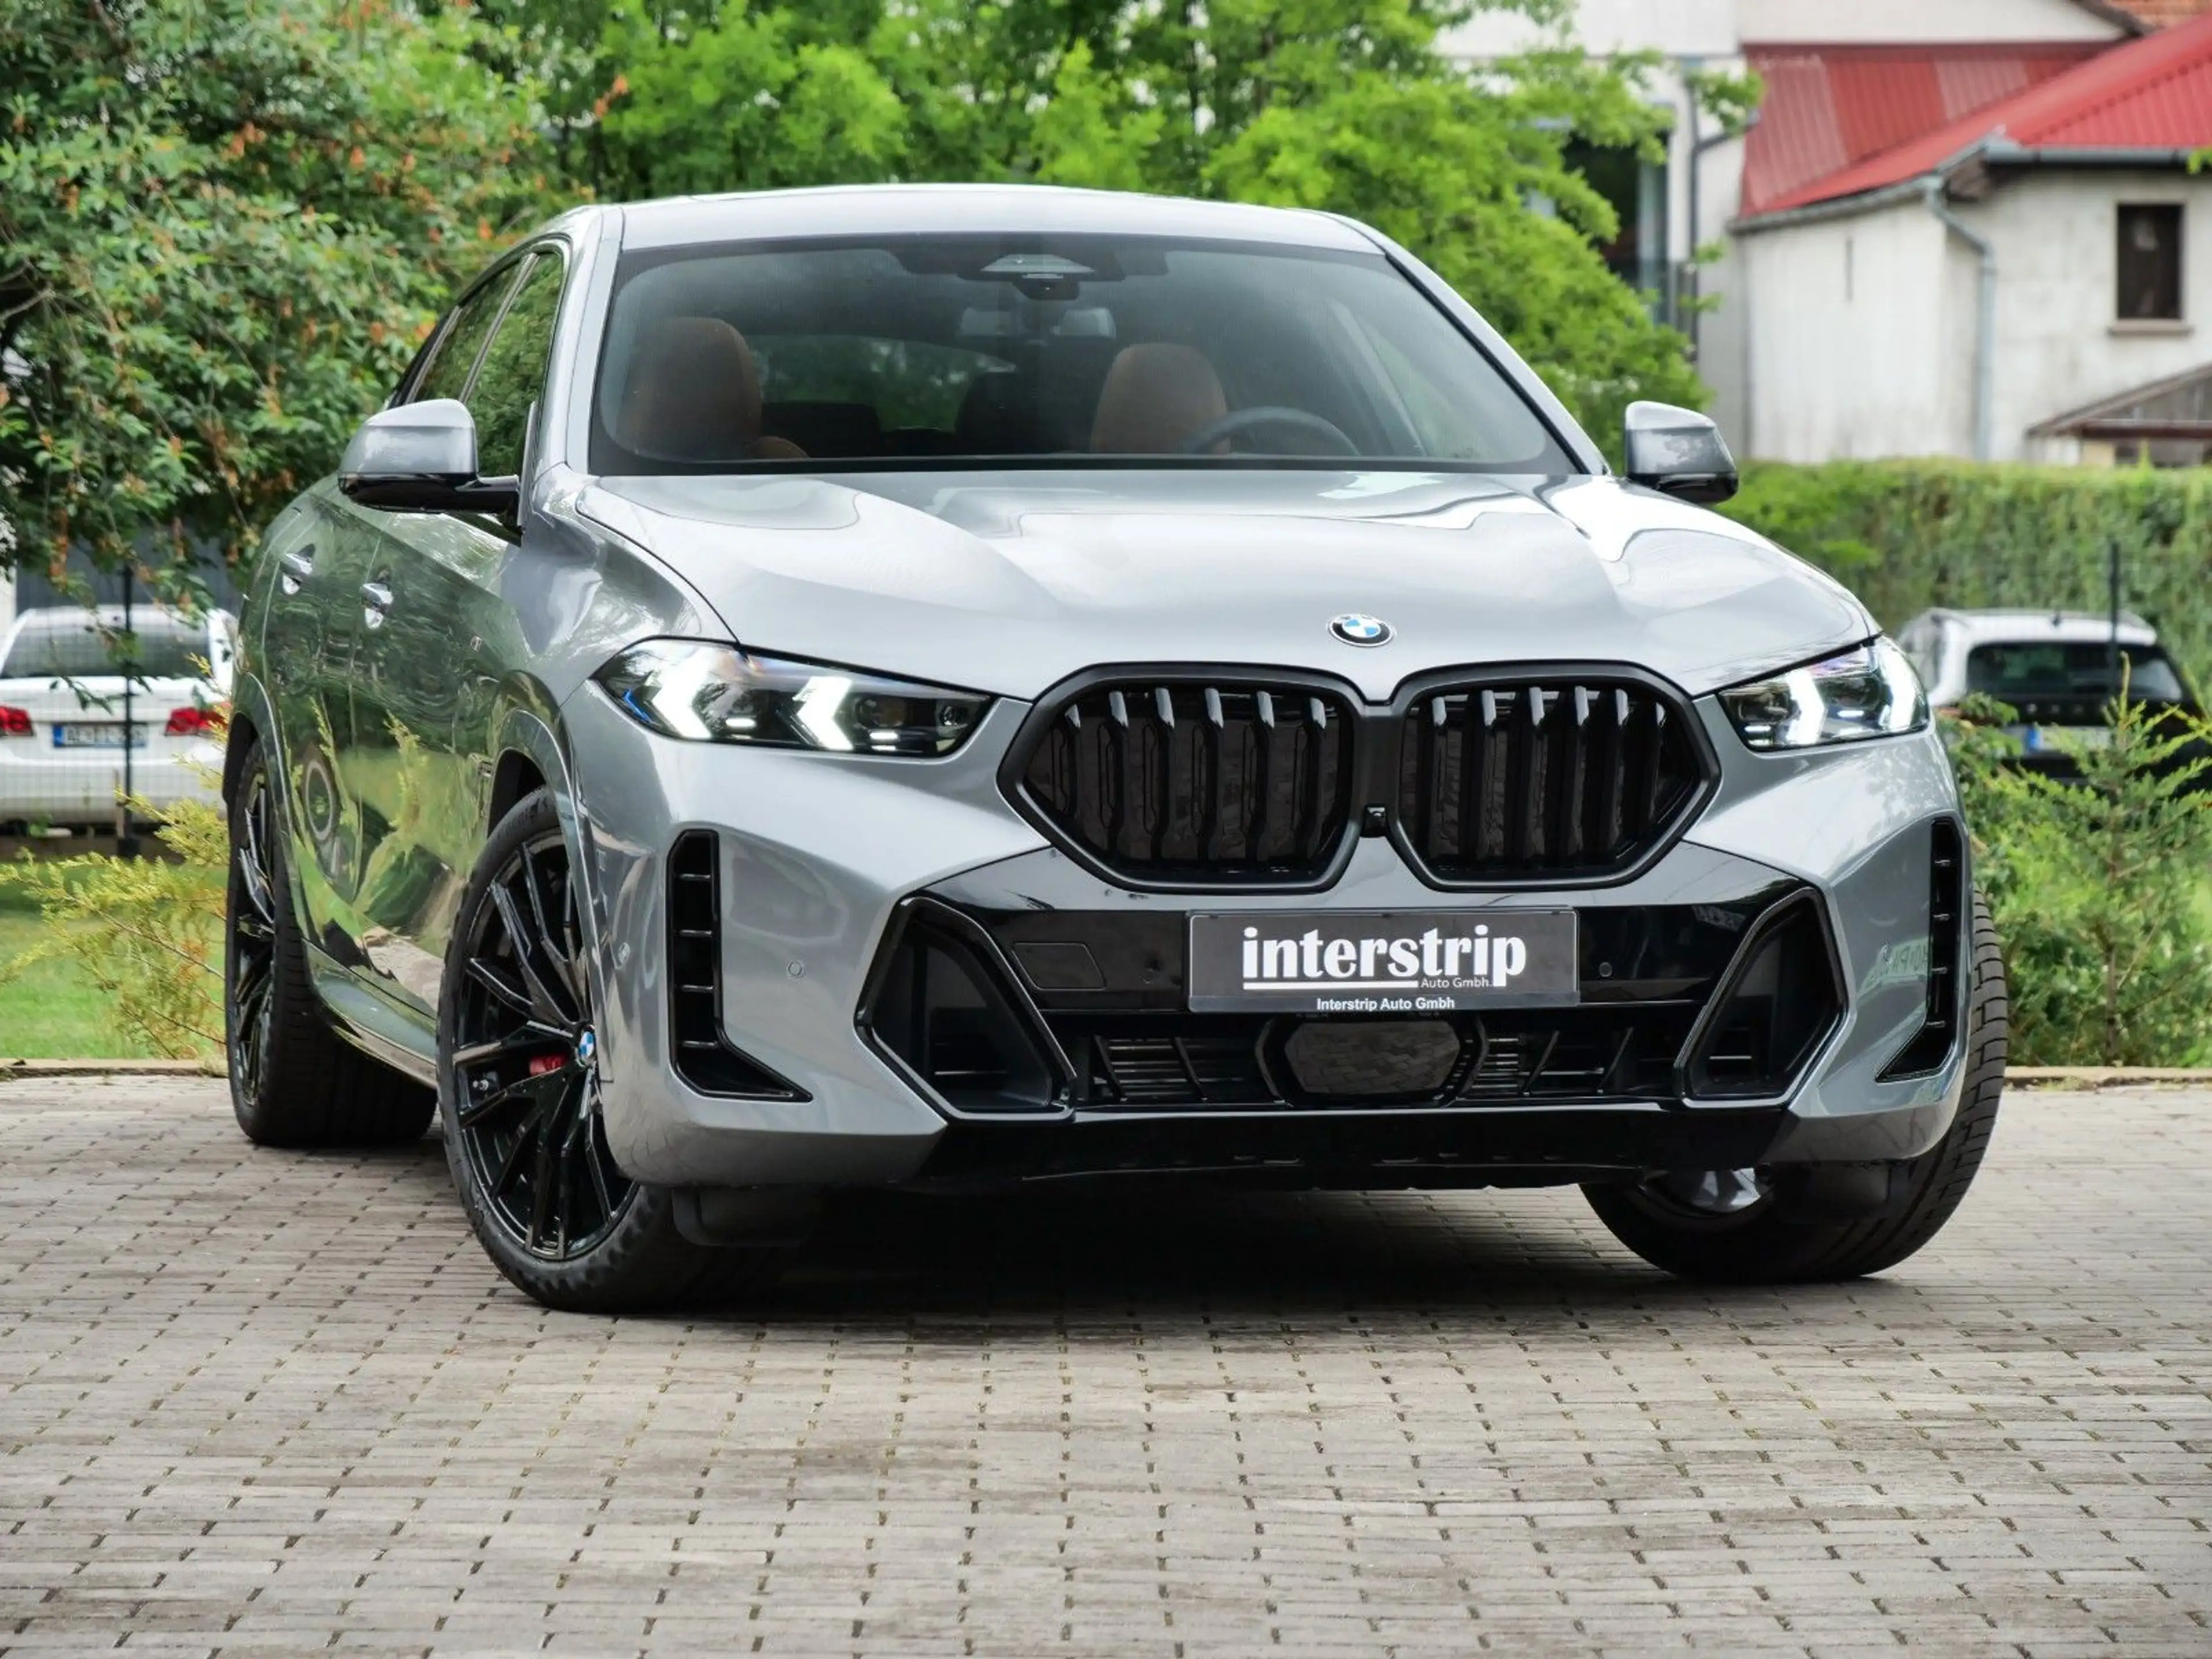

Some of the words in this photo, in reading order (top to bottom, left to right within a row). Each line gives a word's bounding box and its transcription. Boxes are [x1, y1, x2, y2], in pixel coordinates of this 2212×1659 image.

[1243, 924, 1527, 987] interstrip
[1421, 978, 1450, 988] Auto
[1317, 998, 1378, 1012] Interstrip
[1380, 998, 1412, 1011] Auto
[1415, 997, 1455, 1010] Gmbh
